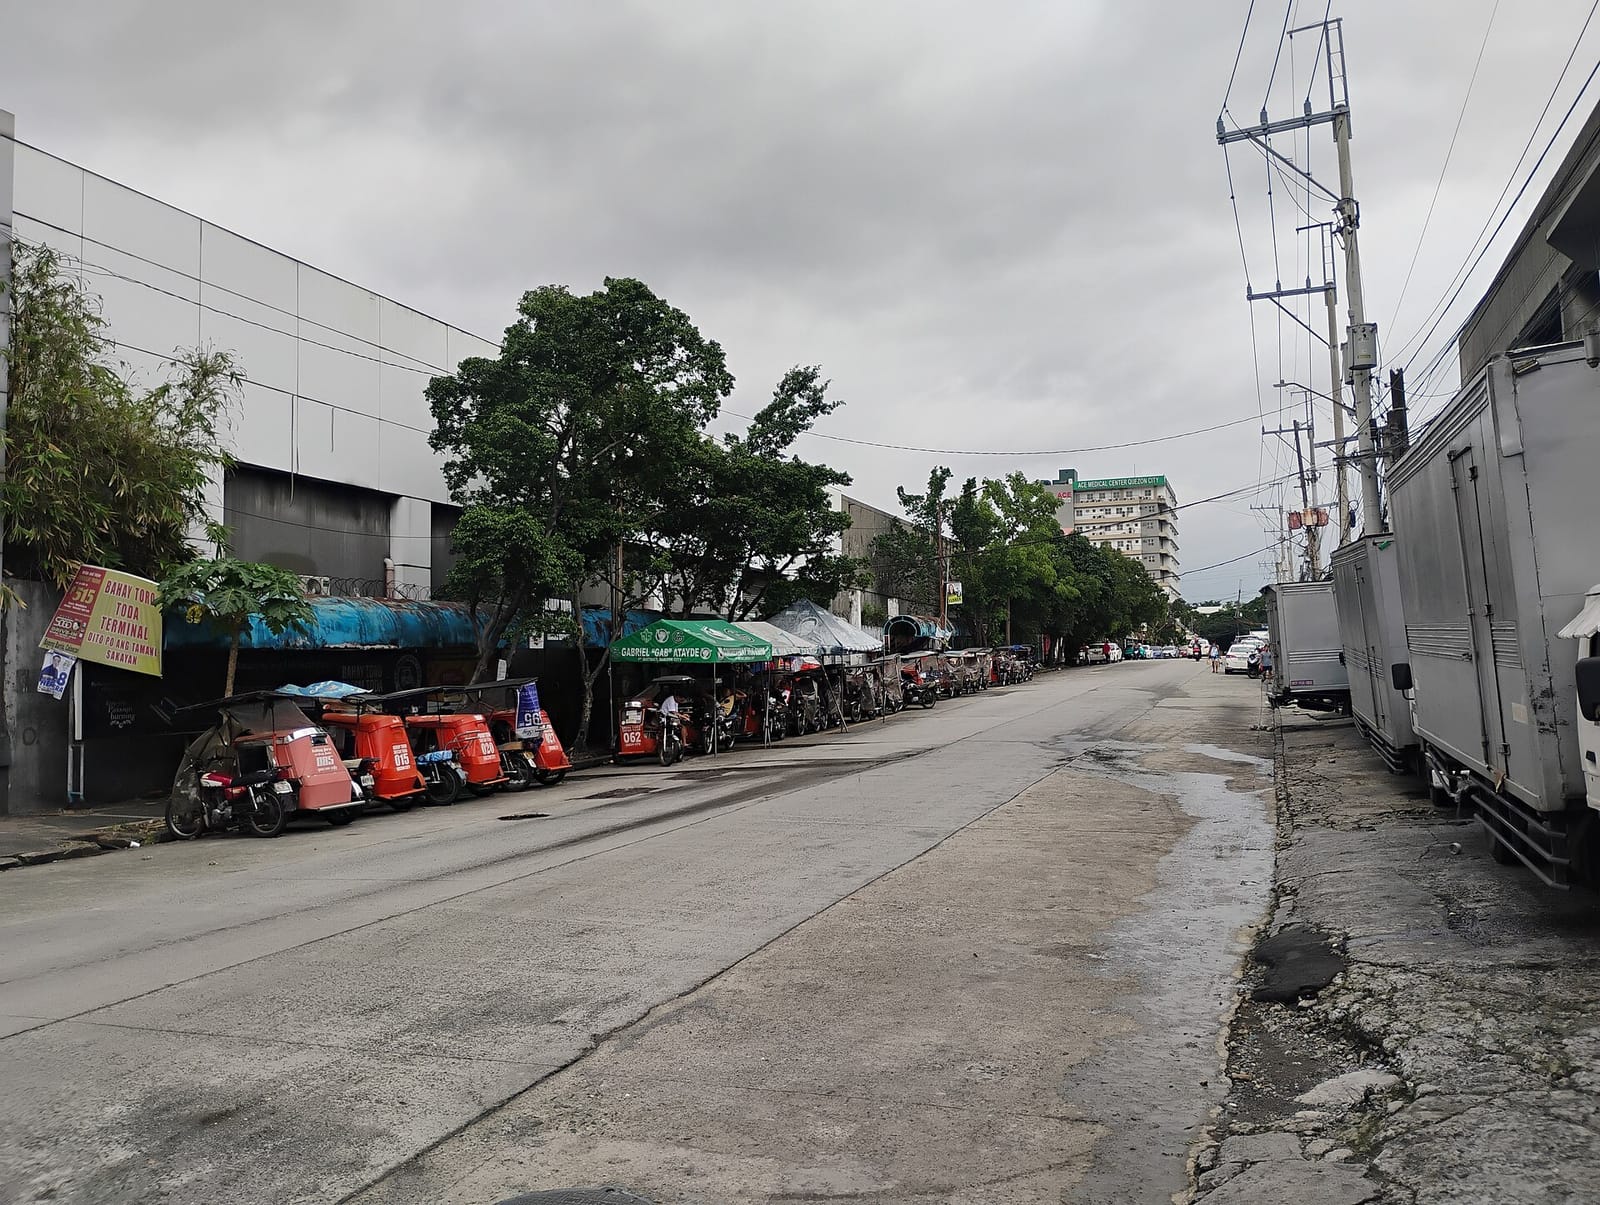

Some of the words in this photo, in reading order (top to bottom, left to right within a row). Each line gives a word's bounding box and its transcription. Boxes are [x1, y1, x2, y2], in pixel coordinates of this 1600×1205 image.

[104, 580, 133, 599] BAHAY
[135, 587, 156, 606] TORO
[115, 602, 139, 621] TODA
[100, 616, 149, 641] TERMINAL
[87, 632, 104, 644] DITO
[104, 635, 115, 646] PO
[115, 637, 130, 651] ANG
[105, 650, 138, 665] SAKAYAN
[621, 647, 650, 657] GABRIEL
[673, 647, 700, 657] ATAYDE
[623, 731, 642, 743] 062
[394, 753, 410, 767] 015
